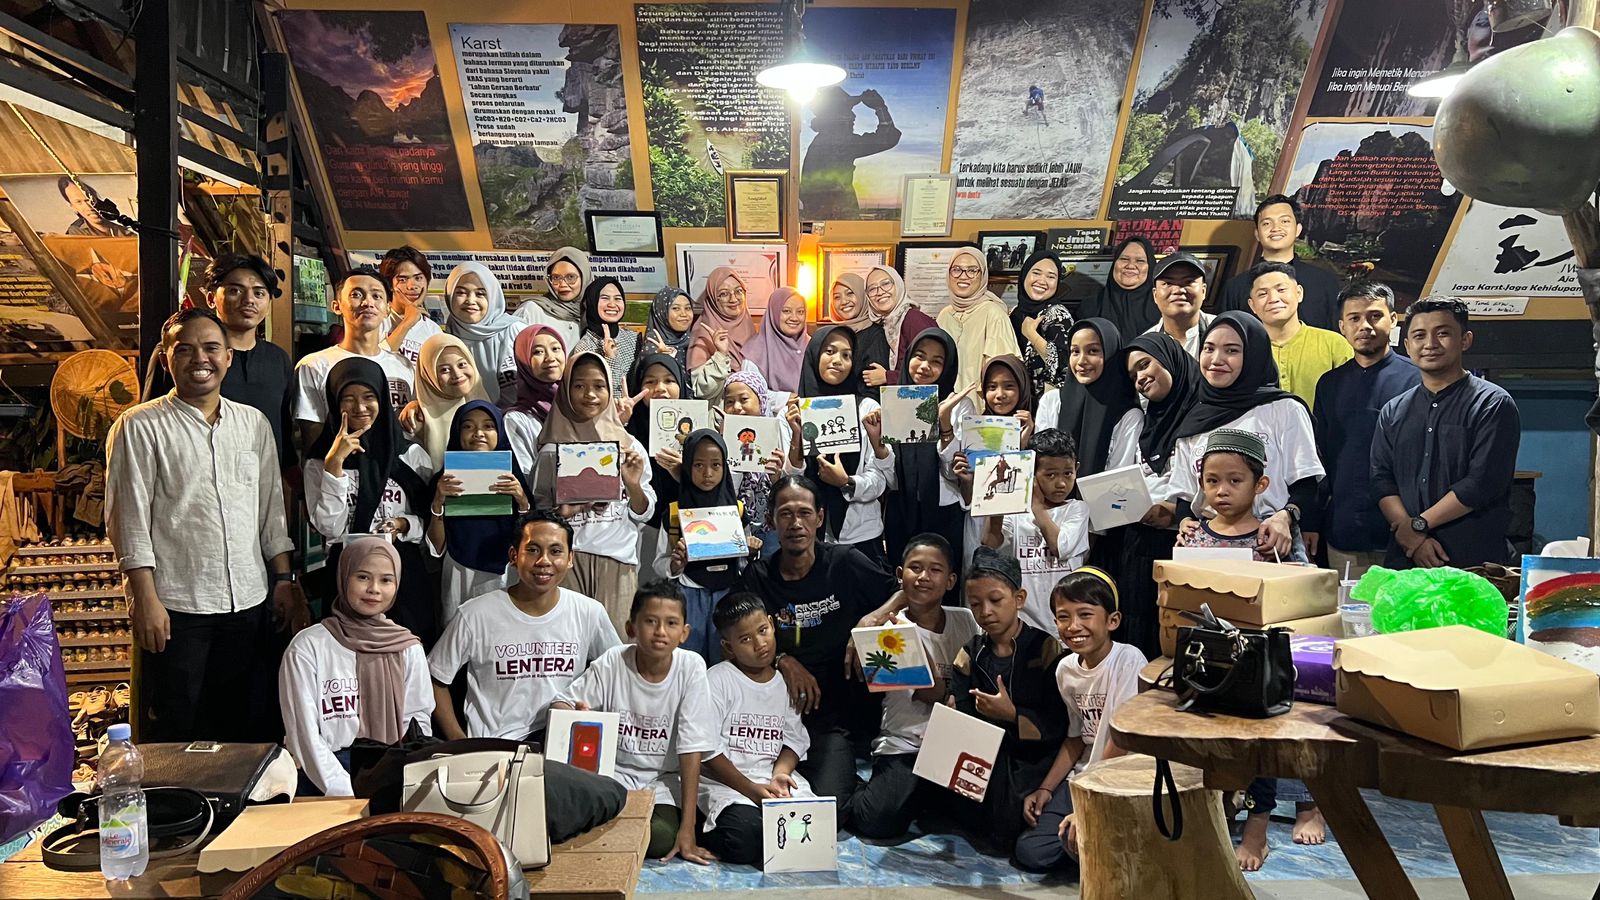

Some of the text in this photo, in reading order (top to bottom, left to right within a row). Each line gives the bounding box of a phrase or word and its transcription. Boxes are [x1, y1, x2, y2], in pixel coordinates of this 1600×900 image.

[460, 36, 502, 49] Karst
[1348, 68, 1367, 79] ingin
[1368, 68, 1401, 77] Memetik
[1344, 82, 1362, 93] ingin
[1363, 82, 1392, 92] Menuai
[959, 162, 992, 174] terkadang
[993, 163, 1006, 173] kita
[1007, 163, 1025, 173] harus
[1026, 163, 1048, 173] sedikit
[1064, 163, 1082, 174] JAUH
[976, 178, 999, 187] melihat
[1000, 178, 1025, 187] sesuatu
[1026, 178, 1048, 189] dengan
[1118, 220, 1184, 231] TUBAN
[512, 274, 536, 282] kepada
[1452, 283, 1475, 292] Jaga
[1530, 284, 1582, 293] Kehidupan
[495, 642, 578, 658] VOLUNTEER
[496, 658, 574, 674] LENTERA
[731, 713, 785, 728] LENTERA
